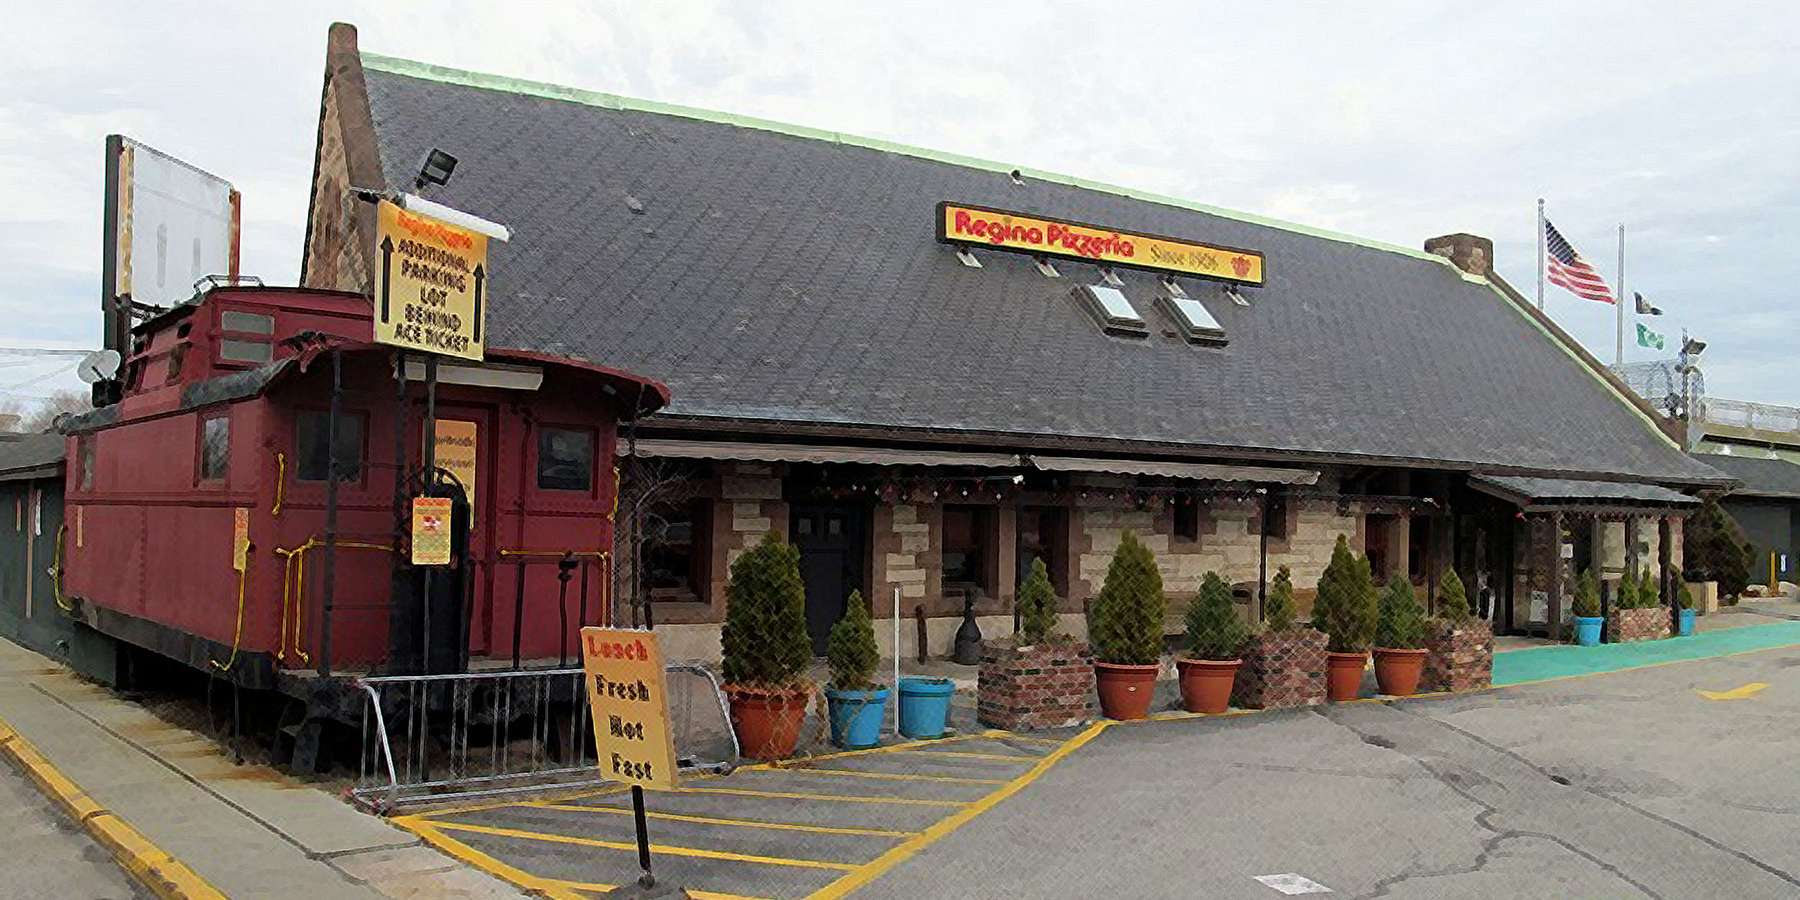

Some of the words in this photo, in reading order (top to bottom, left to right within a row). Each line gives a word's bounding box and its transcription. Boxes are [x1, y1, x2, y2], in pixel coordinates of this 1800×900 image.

[955, 211, 1043, 244] Regina
[1047, 223, 1135, 257] Pizzeria
[399, 239, 469, 273] ADDITIONAL
[401, 258, 466, 293] PARKING
[420, 286, 447, 307] LOT
[404, 303, 462, 332] BEHIND
[394, 322, 422, 344] ACE
[424, 327, 469, 352] TICKET
[587, 634, 649, 662] Lunch
[595, 673, 650, 701] Fresh
[608, 714, 644, 740] Hot
[611, 752, 653, 780] Fast
